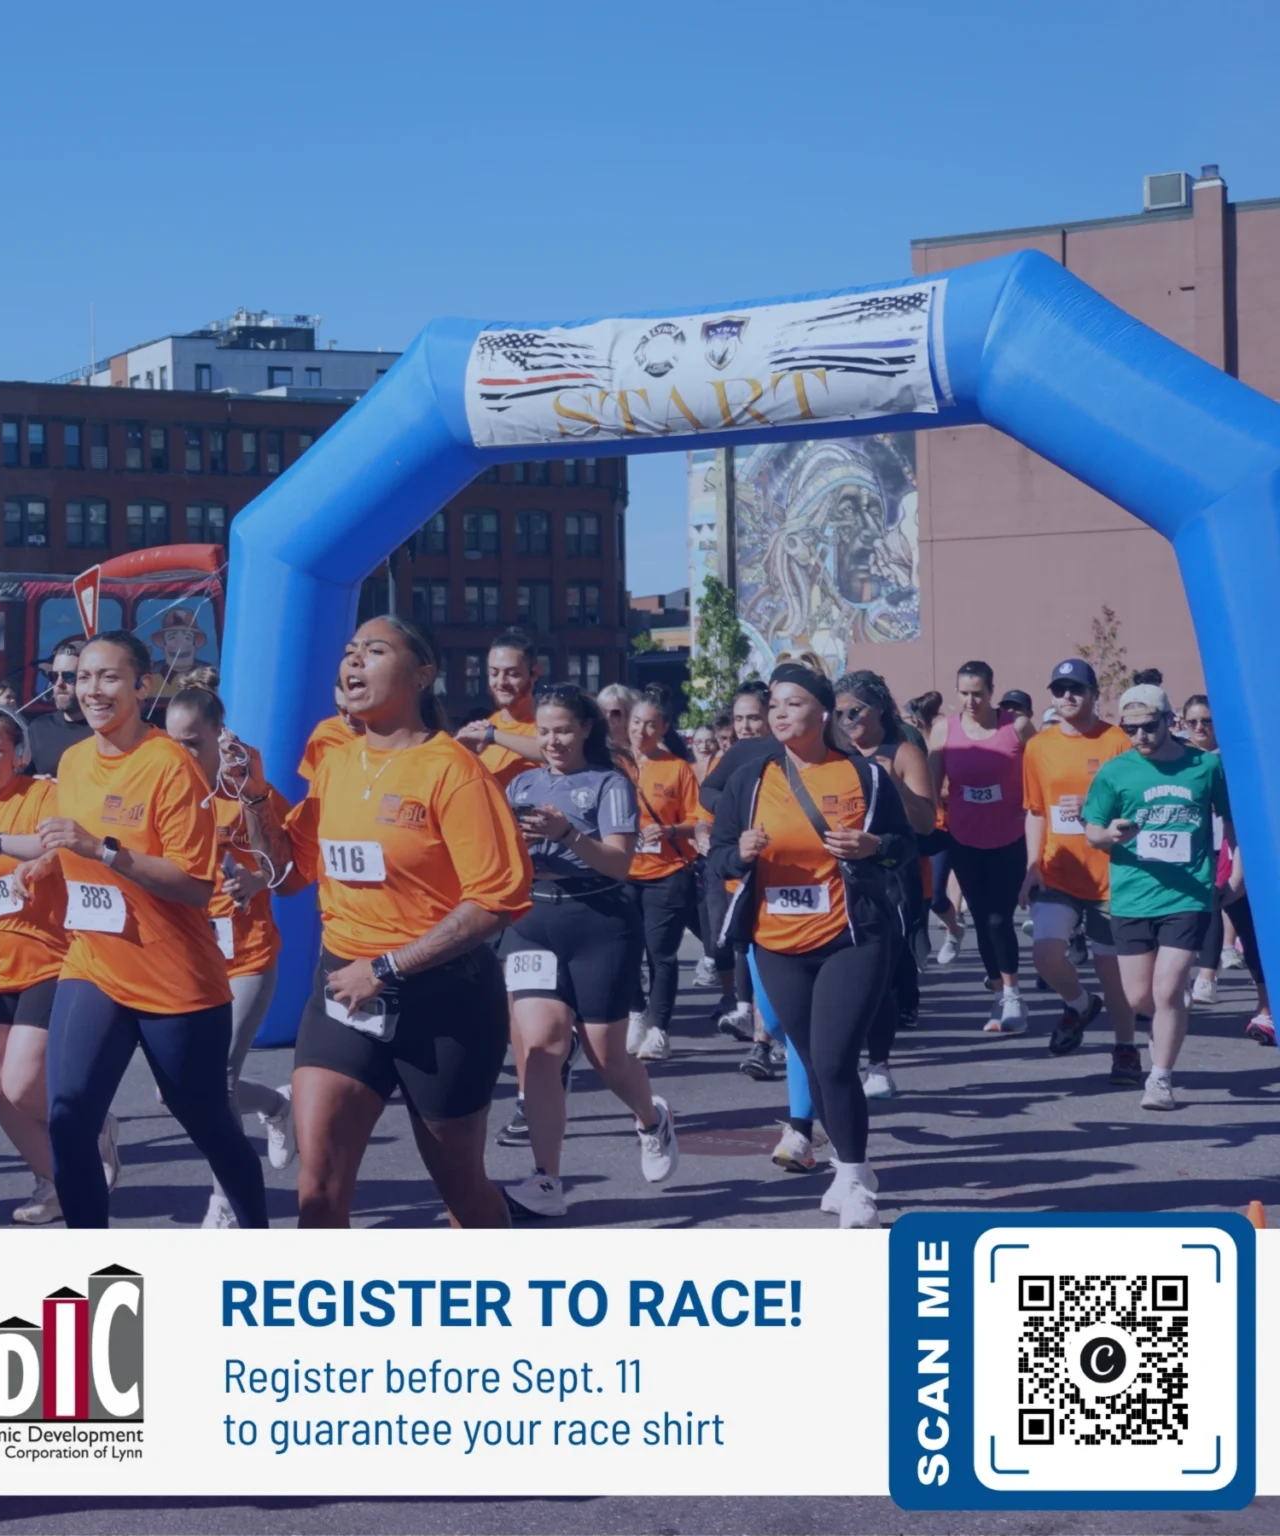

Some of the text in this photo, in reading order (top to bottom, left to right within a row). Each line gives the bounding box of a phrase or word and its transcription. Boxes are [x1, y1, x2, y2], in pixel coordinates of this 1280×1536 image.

[553, 368, 830, 437] START
[1149, 833, 1178, 849] 357
[329, 845, 366, 874] 416
[80, 884, 113, 910] 383
[779, 887, 814, 909] 384
[513, 954, 542, 974] 386
